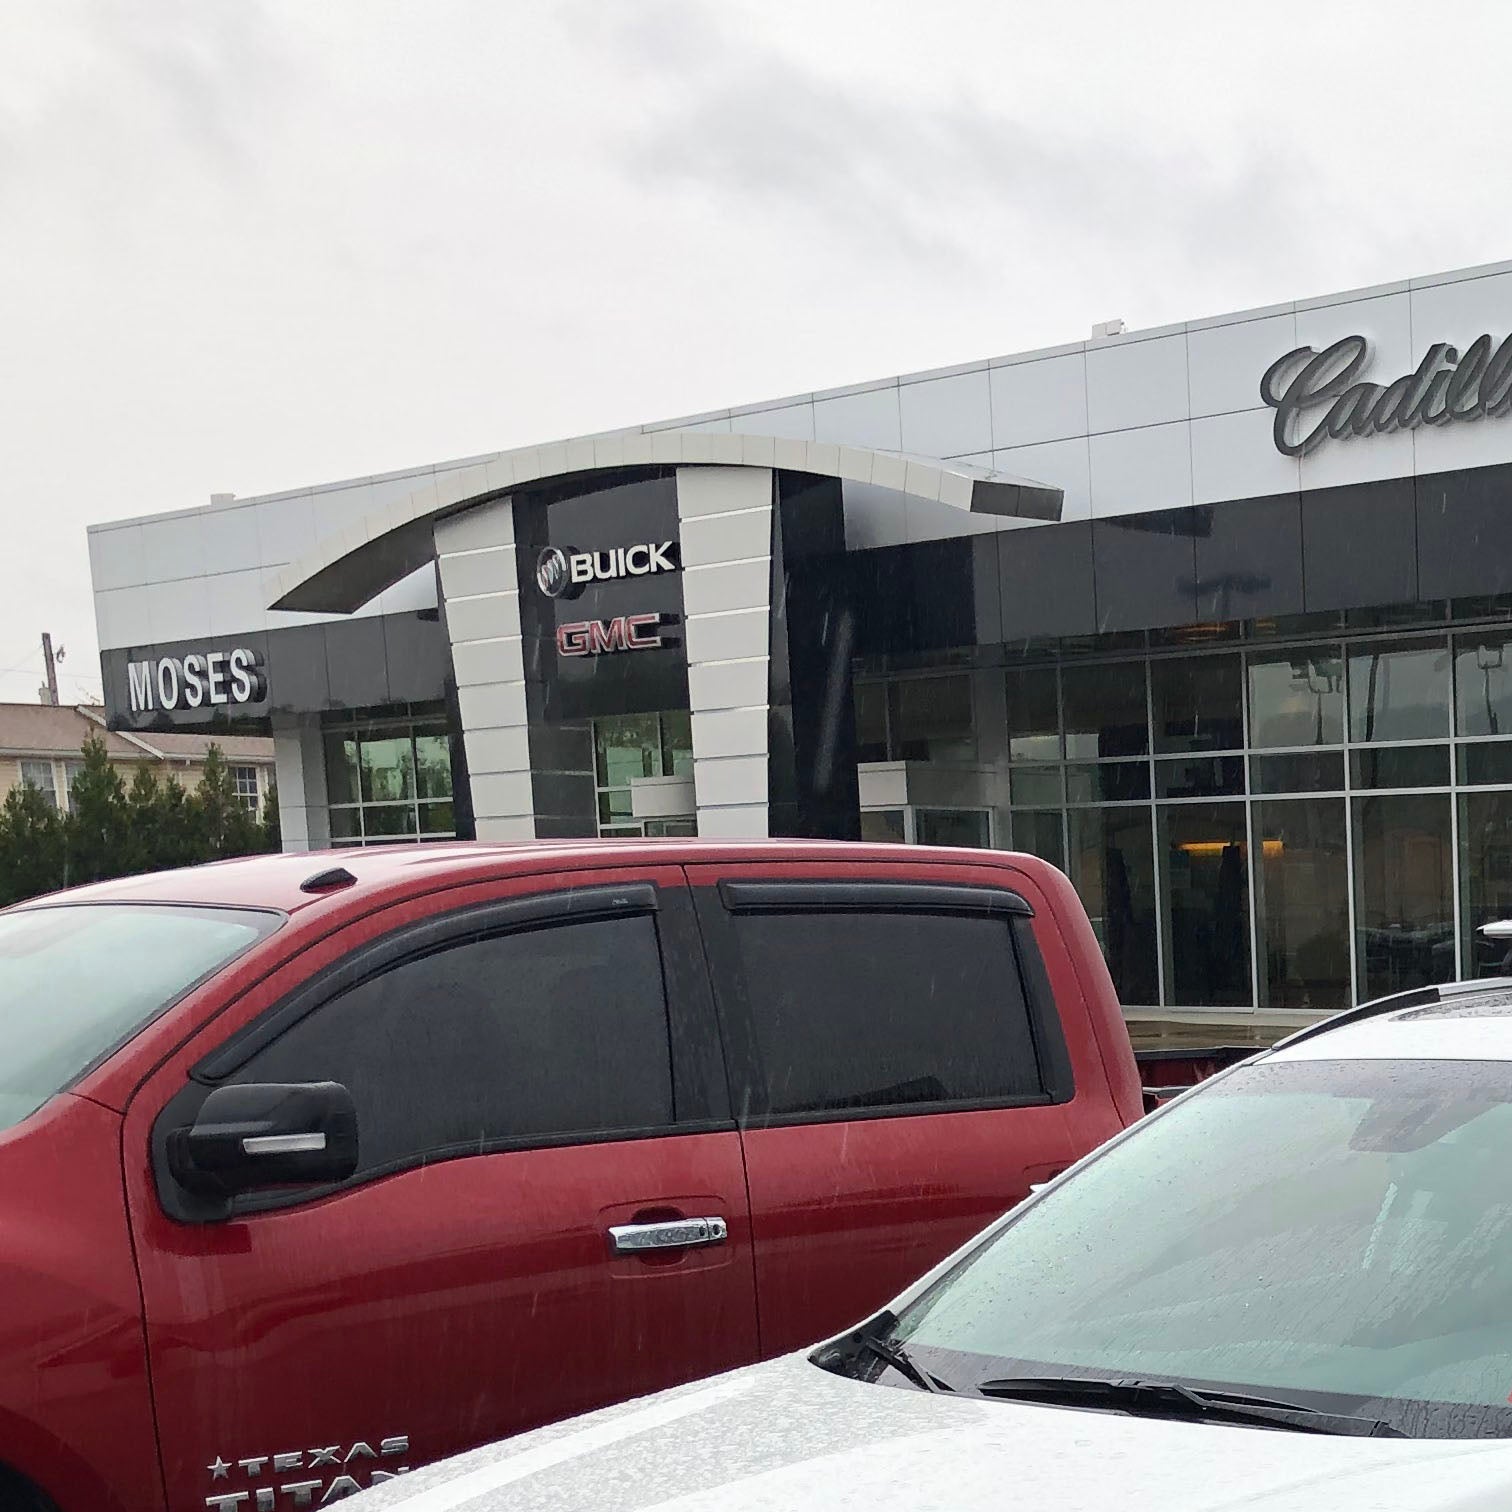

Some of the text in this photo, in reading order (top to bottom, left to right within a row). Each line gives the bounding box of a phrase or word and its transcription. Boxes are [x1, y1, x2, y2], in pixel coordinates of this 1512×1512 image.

[569, 540, 676, 584] BUICK
[556, 612, 662, 657] GMC
[127, 648, 252, 712] MOSES
[237, 1435, 410, 1478] TEXAS
